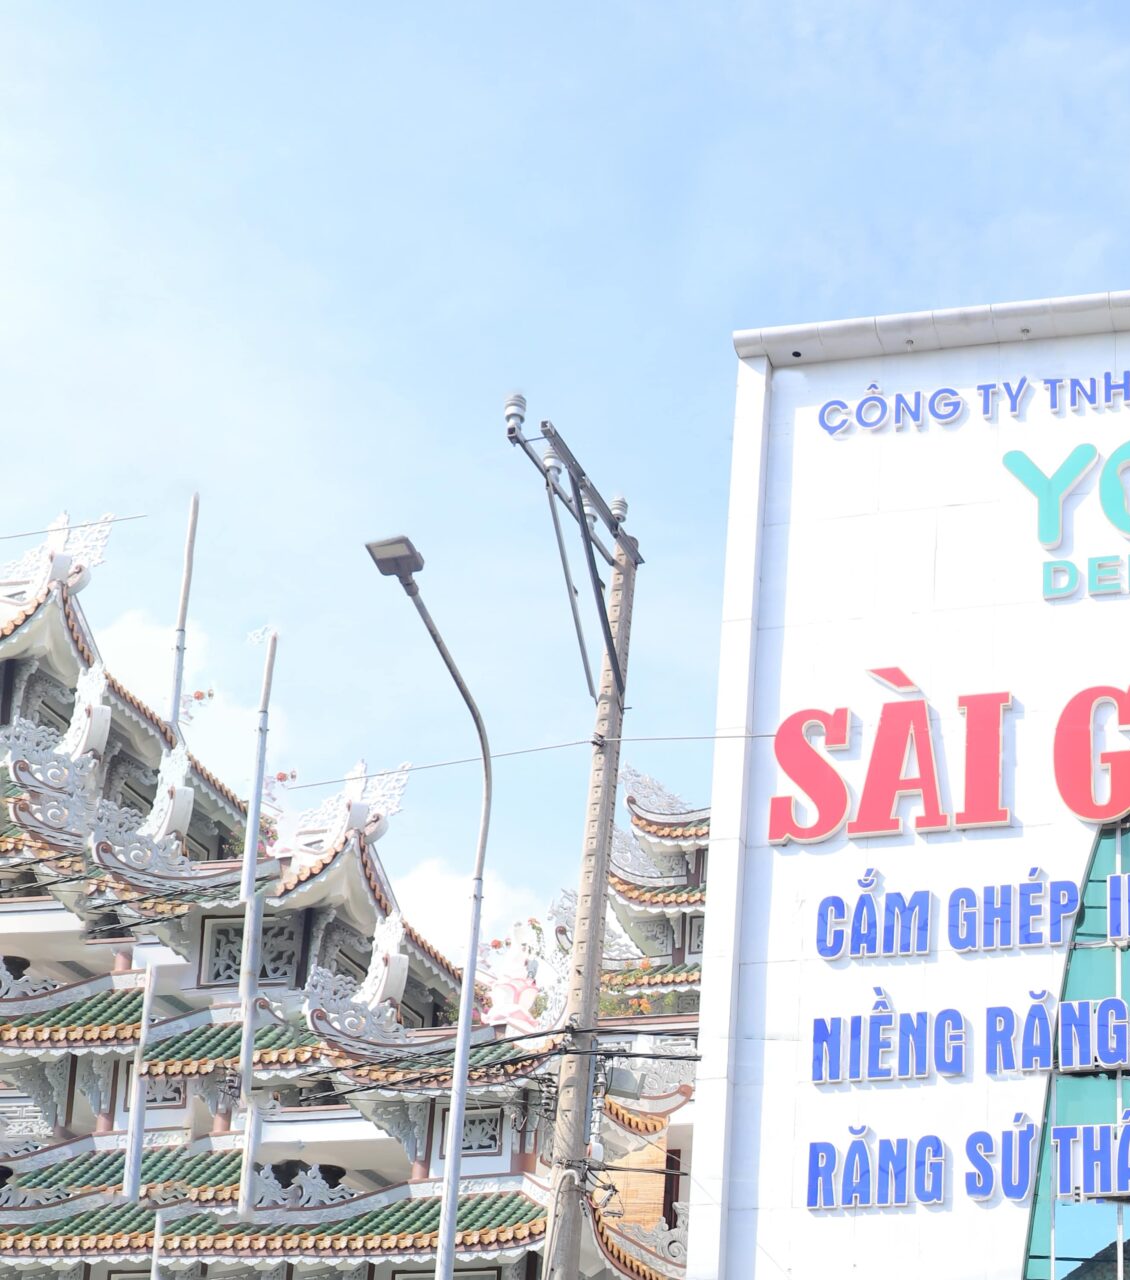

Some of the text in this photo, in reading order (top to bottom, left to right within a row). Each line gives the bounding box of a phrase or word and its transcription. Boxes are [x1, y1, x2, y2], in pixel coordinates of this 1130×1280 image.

[818, 383, 962, 436] CÔNG
[976, 376, 1029, 418] TY
[767, 665, 1013, 846] SÀI
[815, 867, 932, 960] CẮM
[947, 866, 1081, 952] GHÉP
[811, 986, 967, 1085] NIỀNG
[807, 1123, 946, 1210] RĂNG
[965, 1111, 1039, 1203] SỨ
